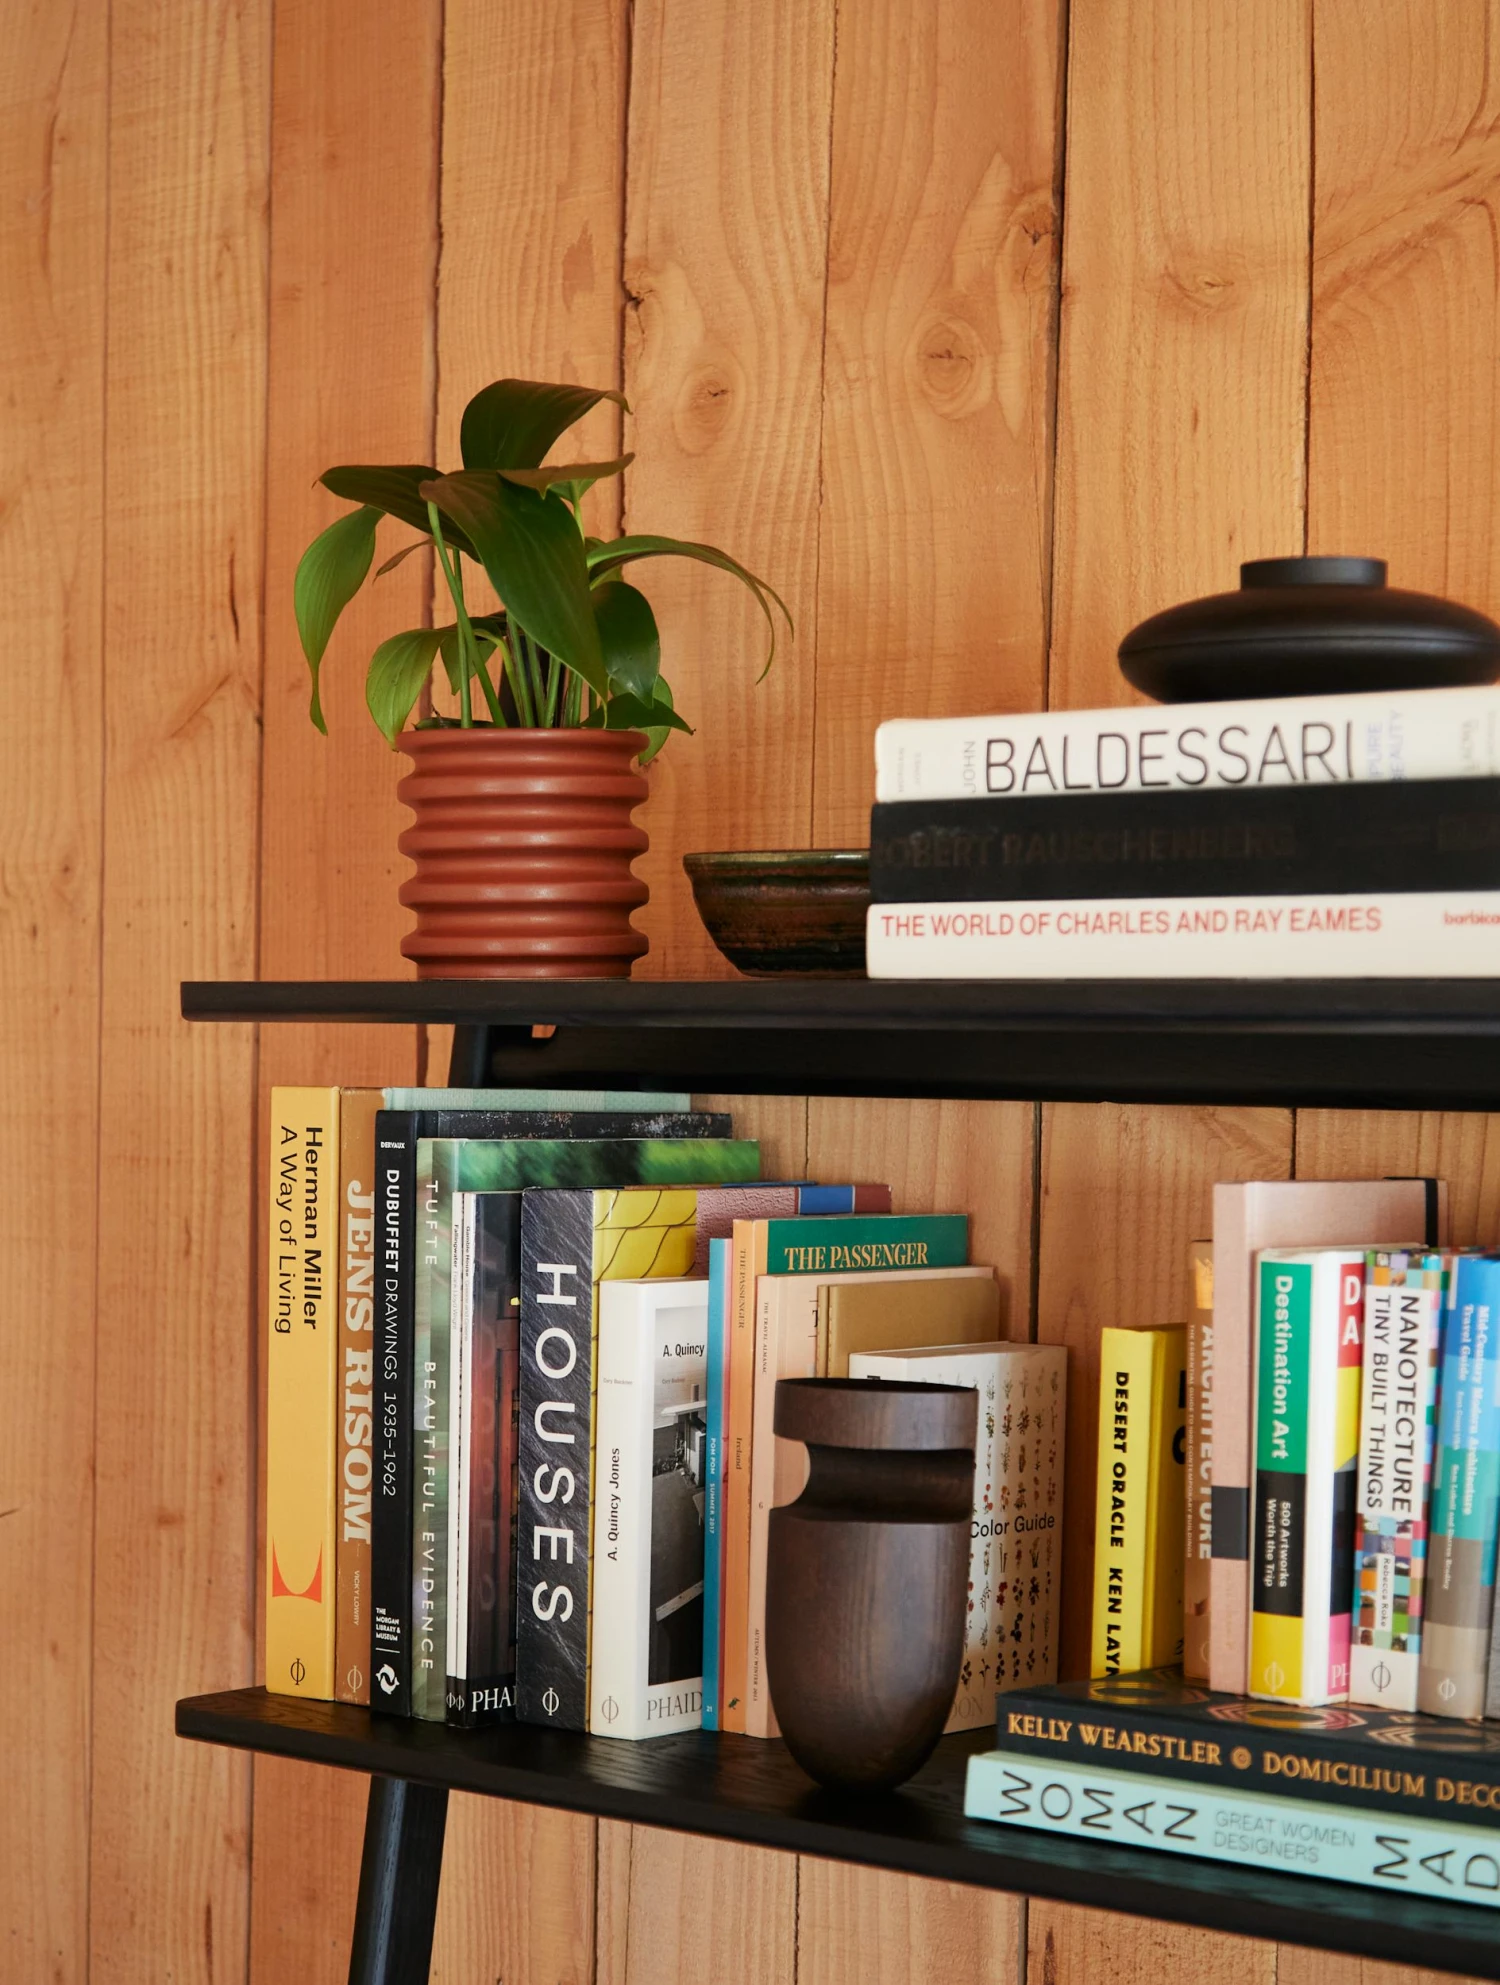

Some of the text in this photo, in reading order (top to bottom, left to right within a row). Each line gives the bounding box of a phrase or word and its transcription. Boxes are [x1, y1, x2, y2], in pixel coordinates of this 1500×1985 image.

[963, 741, 976, 794] JOHN
[986, 719, 1353, 793] BALDESSARI
[1367, 723, 1383, 778] PURE
[881, 906, 1382, 937] THE WORLD OF CHARLES AND RAY EAMES
[380, 1141, 405, 1149] DERVAUX
[274, 1125, 298, 1334] A Way of Living
[302, 1126, 323, 1330] Herman Miller
[384, 1169, 400, 1273] DUBUFFET
[784, 1242, 929, 1271] THE PASSENGER
[383, 1278, 399, 1380] DRAWINGS
[738, 1272, 746, 1329] PASSENGER
[343, 1180, 375, 1545] JENS RISOM
[663, 1342, 705, 1358] A. Quincy
[1271, 1275, 1293, 1460] Destination Art
[1458, 1304, 1475, 1381] Travel Guide
[421, 1180, 438, 1670] TUFTE BEAUTIFUL EVIDENCE
[1114, 1371, 1130, 1453] DESERT
[1367, 1295, 1391, 1508] TINY BUILT THINGS
[1392, 1295, 1420, 1513] NANOTECTURE
[1462, 1305, 1490, 1516] Mid-Century Modern Architecture
[532, 1262, 578, 1623] HOUSES
[607, 1448, 621, 1561] A. Quincy Jones
[971, 1512, 1055, 1539] Color Guide
[1110, 1462, 1127, 1548] ORACLE
[1264, 1498, 1277, 1588] Worth the Trip
[1279, 1501, 1291, 1588] 500 Artworks
[1442, 1559, 1453, 1591] Bradley
[376, 1607, 386, 1615] THE
[376, 1616, 400, 1625] MORGAN
[1107, 1567, 1123, 1614] KEN
[1380, 1558, 1390, 1627] Rebecca Roke
[376, 1623, 396, 1633] LIBRARY
[376, 1632, 398, 1642] MUSEUM
[1008, 1712, 1072, 1742] KELLY
[1078, 1723, 1223, 1767] WEARSTLER
[1263, 1751, 1427, 1798] DOMICILIUM
[999, 1770, 1199, 1841] WOMAN
[1215, 1809, 1356, 1848] GREAT WOMEN
[1214, 1831, 1319, 1864] DESIGNERS
[1373, 1835, 1500, 1891] MAD
